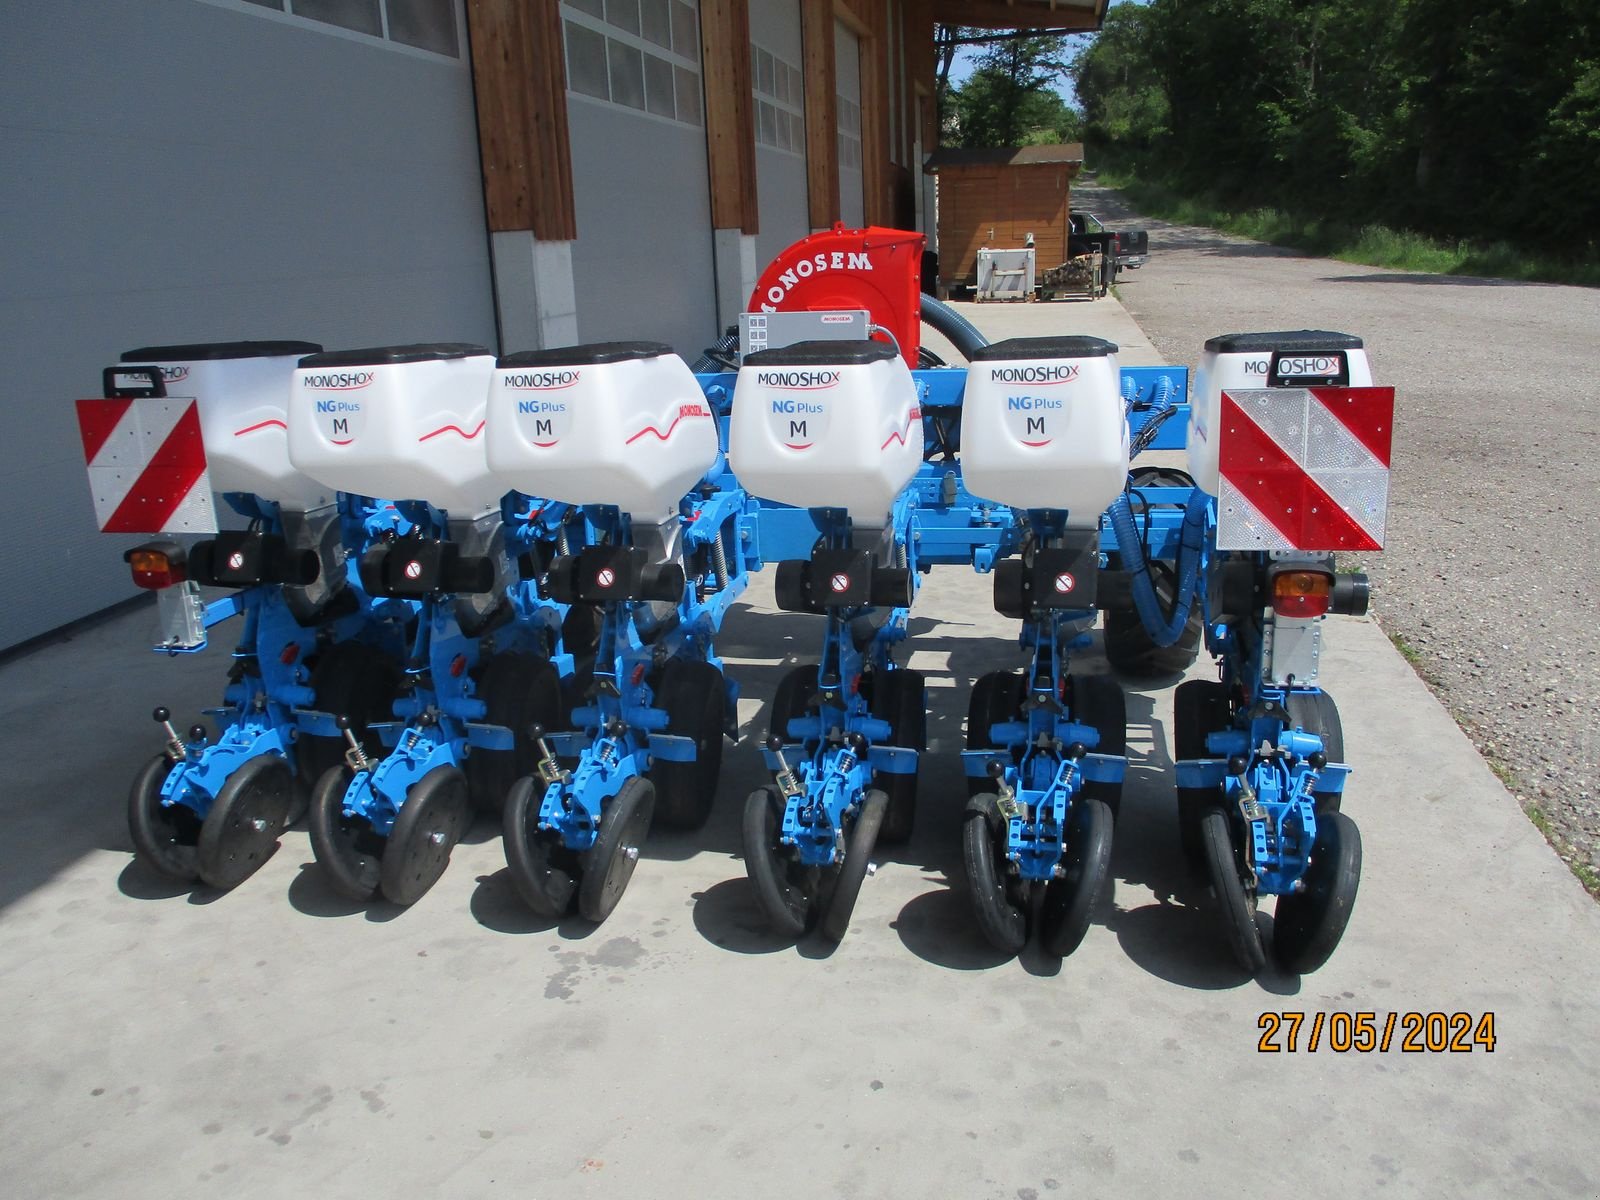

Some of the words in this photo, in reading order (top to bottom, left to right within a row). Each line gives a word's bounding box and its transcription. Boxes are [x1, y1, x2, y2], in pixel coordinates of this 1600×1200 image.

[991, 365, 1080, 382] MONOSHOX
[1244, 356, 1338, 375] MOOSHOX
[304, 371, 375, 388] MONOSHOX
[504, 371, 581, 388] MONOSHOX
[758, 371, 841, 388] MONOSHOX
[317, 400, 336, 412] NG
[338, 401, 360, 412] Plus
[518, 400, 539, 413] NG
[541, 401, 566, 412] Plus
[772, 400, 795, 413] NG
[797, 401, 823, 414] Plus
[1008, 397, 1032, 410] NG
[1034, 397, 1063, 409] Plus
[333, 418, 348, 434] M
[536, 419, 552, 436] M
[790, 420, 807, 438] M
[1027, 416, 1045, 435] M
